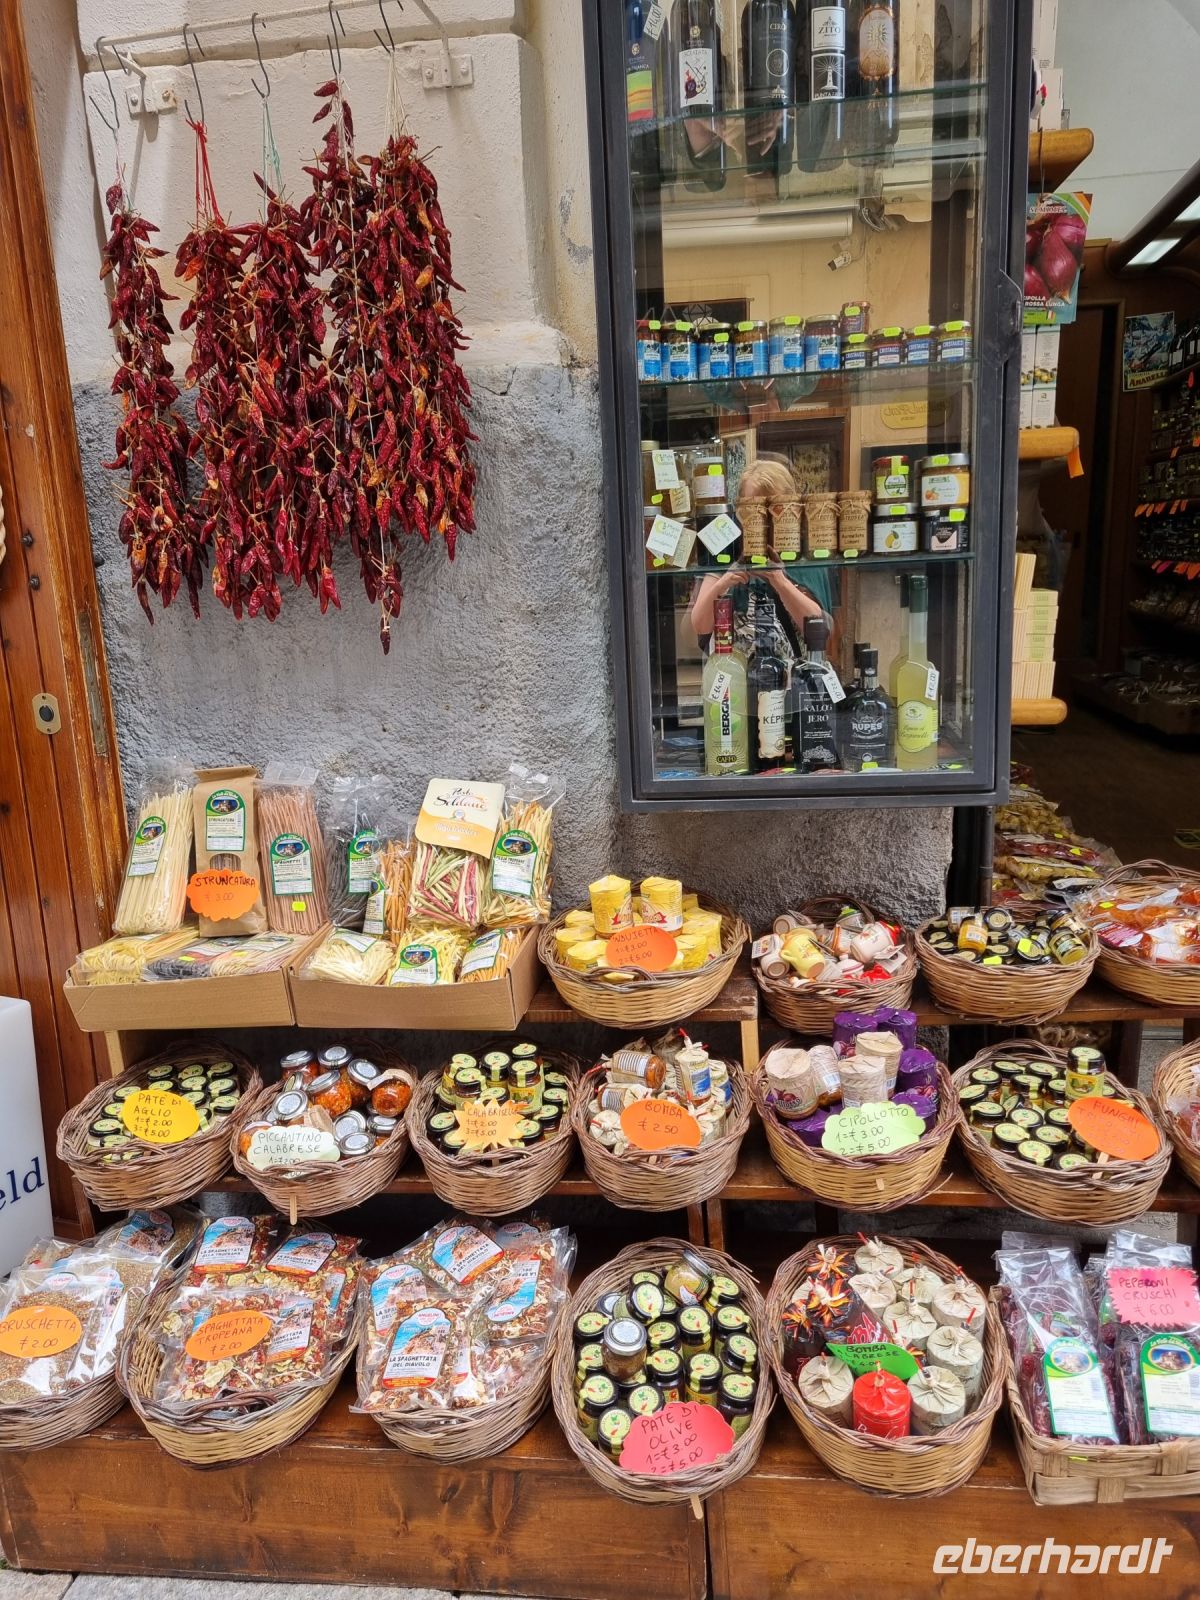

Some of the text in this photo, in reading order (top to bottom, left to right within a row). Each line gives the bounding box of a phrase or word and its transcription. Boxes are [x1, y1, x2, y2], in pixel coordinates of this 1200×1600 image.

[818, 26, 841, 35] ZITO
[807, 715, 829, 724] JERO
[852, 723, 883, 731] RUPES
[194, 875, 256, 888] STRUNCATURA
[133, 1105, 172, 1118] AGLIO
[644, 1101, 683, 1119] BOMBA
[839, 1107, 909, 1128] CIPOLLOTTO
[253, 1143, 321, 1155] CALABRESE
[1123, 1288, 1177, 1300] CRUSCHI
[196, 1317, 263, 1337] SPAGHETTATA
[194, 1326, 253, 1345] TROPEANA
[846, 1344, 887, 1354] BOMBA
[682, 1404, 699, 1418] DI
[649, 1422, 693, 1450] OLIVE
